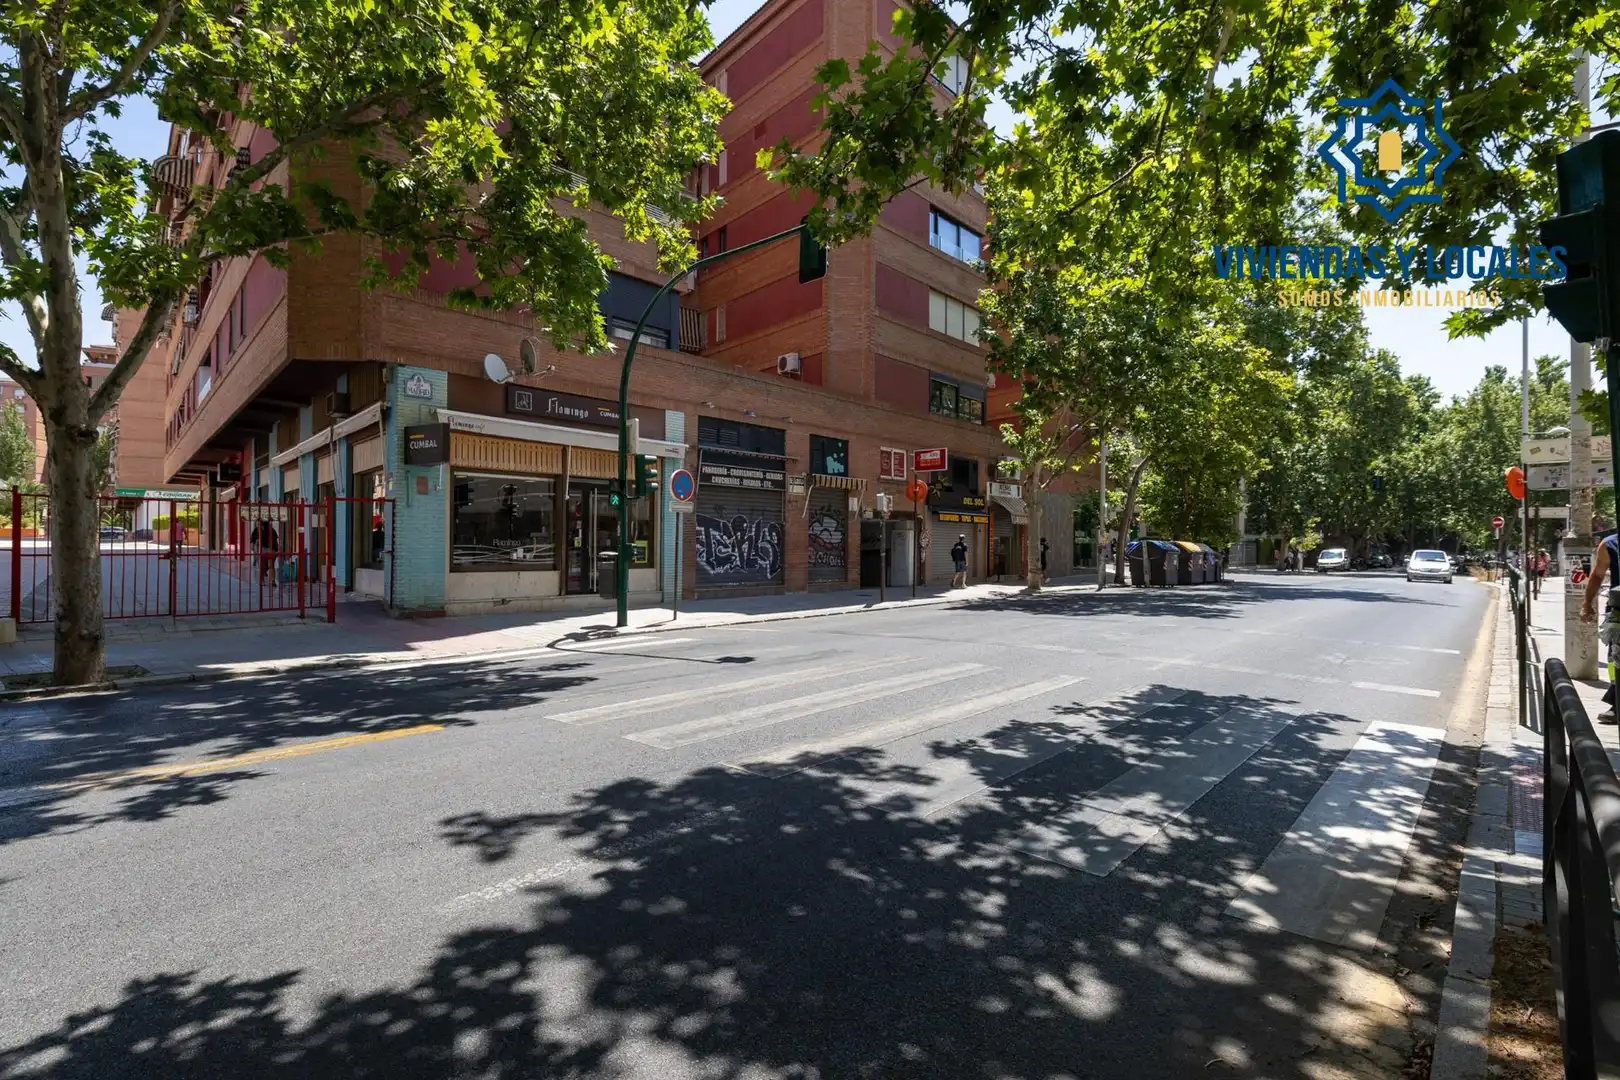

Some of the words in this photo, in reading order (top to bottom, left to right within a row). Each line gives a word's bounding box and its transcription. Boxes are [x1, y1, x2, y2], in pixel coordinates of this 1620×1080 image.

[545, 397, 589, 419] Flamingo
[600, 410, 620, 419] CUMBA
[409, 439, 438, 450] CUMBAL
